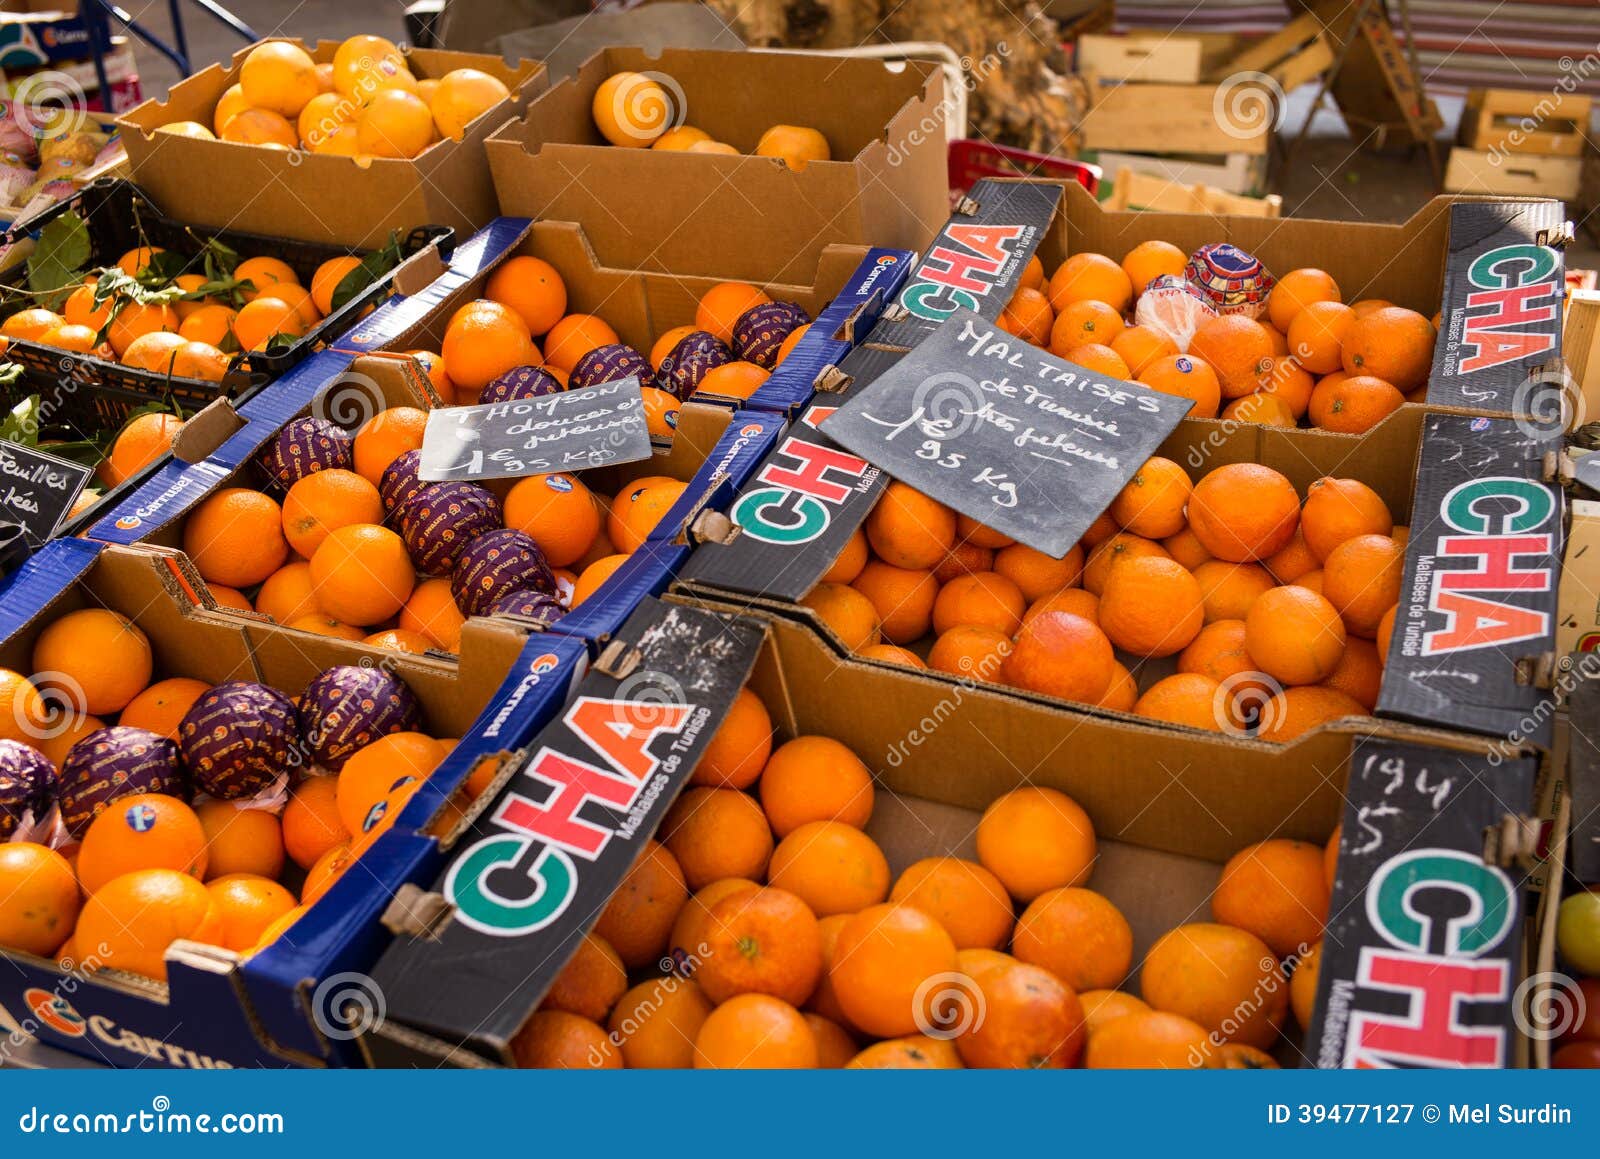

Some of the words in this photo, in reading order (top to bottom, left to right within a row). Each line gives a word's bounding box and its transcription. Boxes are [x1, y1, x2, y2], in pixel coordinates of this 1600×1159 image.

[1013, 247, 1025, 259] de
[1016, 225, 1037, 248] Tunisie
[856, 265, 887, 295] Carrusel
[900, 222, 1027, 323] CHA
[994, 258, 1019, 288] Maltaises
[1448, 307, 1465, 341] Maltaises
[1457, 243, 1560, 375] CHA
[1443, 351, 1460, 376] Tunisie
[1447, 341, 1459, 351] de
[136, 475, 194, 517] Carrusel
[730, 406, 869, 545] CH
[854, 466, 881, 494] Maltai
[1410, 555, 1435, 603] Maltaises
[1420, 476, 1556, 658] CHA
[1408, 602, 1428, 618] de
[1401, 620, 1427, 657] Tunisie
[482, 673, 541, 738] Carrusel
[670, 707, 711, 753] Tunisie
[661, 754, 682, 774] de
[443, 695, 697, 938] CHA
[614, 773, 670, 841] Maltaises
[1341, 848, 1518, 1069] CH
[88, 1015, 234, 1069] Carru
